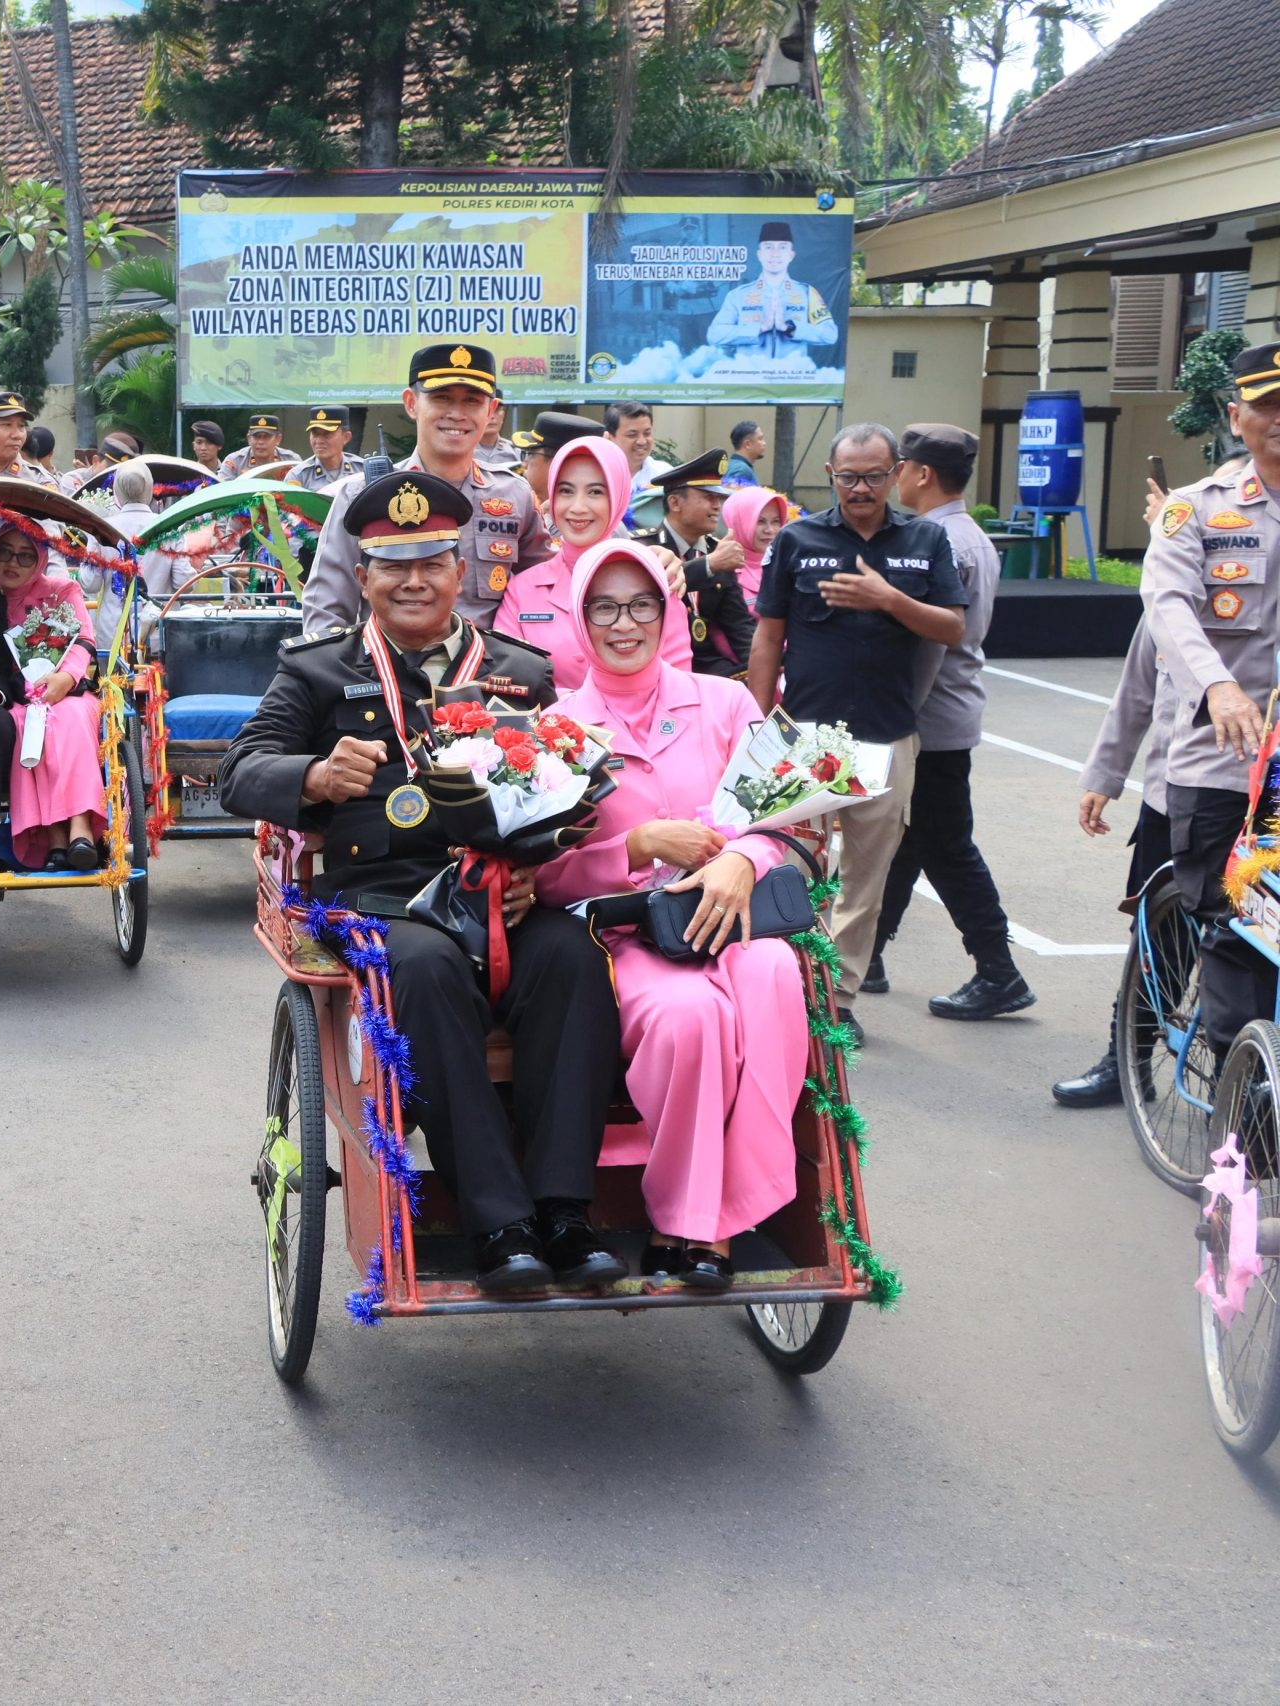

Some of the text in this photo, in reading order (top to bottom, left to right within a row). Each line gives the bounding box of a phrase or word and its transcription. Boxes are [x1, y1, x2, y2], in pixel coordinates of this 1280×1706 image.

[400, 182, 608, 193] KEPOLISIAN DAERAH JAWA TIMU
[442, 199, 574, 209] POLRES KEDIRI KOTA
[241, 243, 524, 270] ANDA MEMASUKI KAWASAN
[683, 247, 718, 261] POLISI
[719, 246, 746, 261] YANG
[596, 265, 631, 280] TERUS
[633, 265, 684, 280] MENEBAR
[228, 275, 542, 302] ZONA INTEGRITAS (ZI) MENUJU
[192, 307, 576, 335] WILAYAH BEBAS DARI KORUPSI (WBK)
[478, 519, 519, 535] POLRI
[800, 557, 839, 569] YOYO
[887, 557, 930, 571] TIK POLRI
[184, 790, 199, 802] AG
